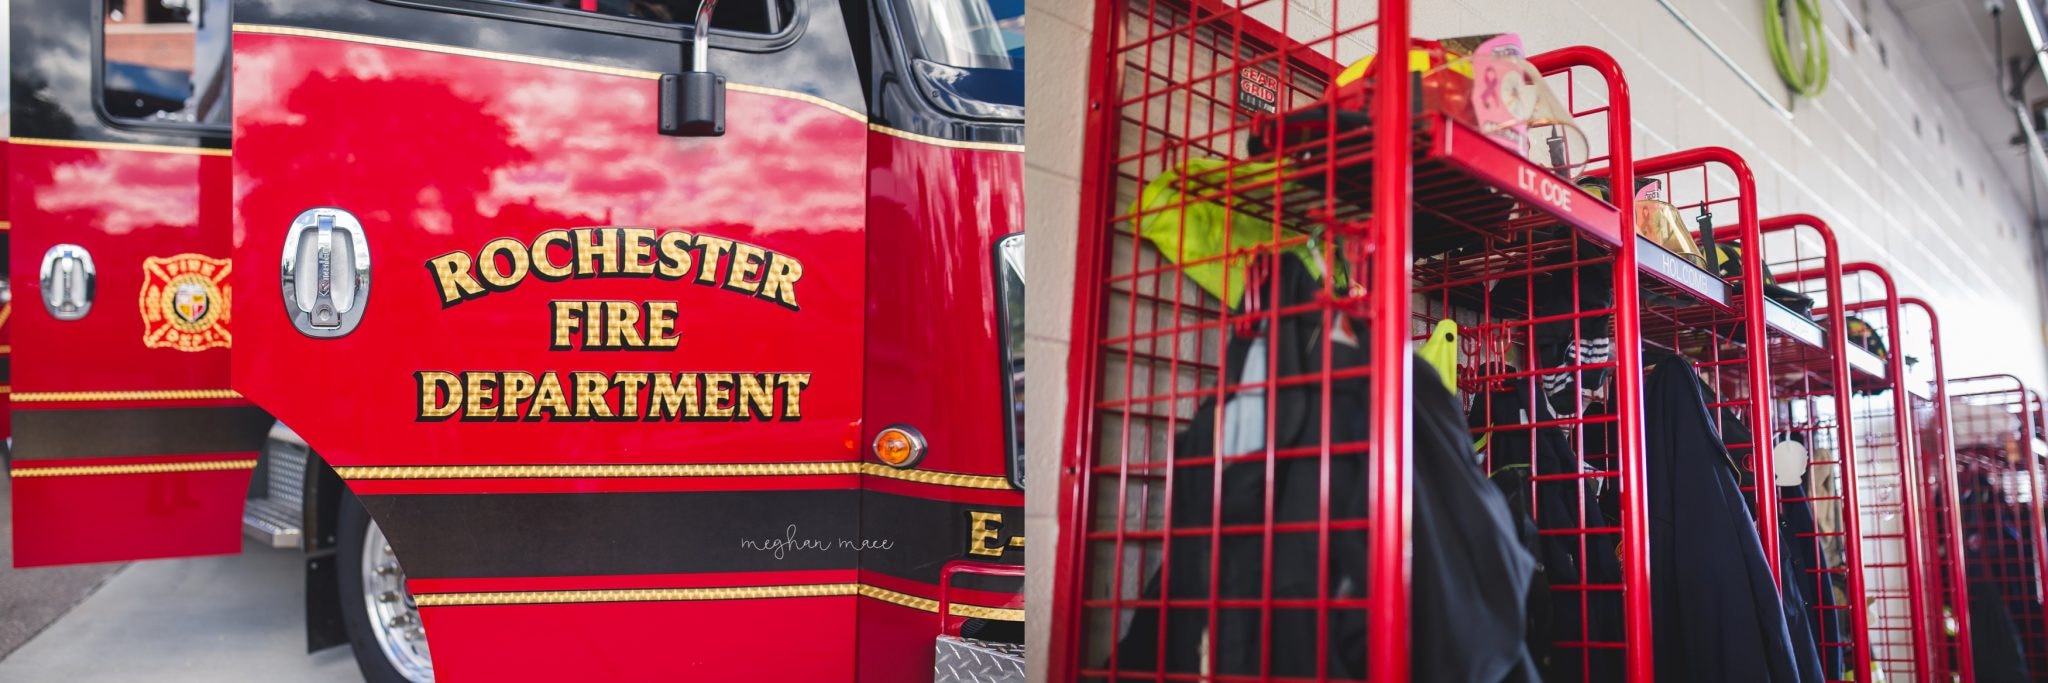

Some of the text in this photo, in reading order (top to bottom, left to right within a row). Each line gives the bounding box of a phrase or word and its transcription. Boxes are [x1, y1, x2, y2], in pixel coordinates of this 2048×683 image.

[1241, 79, 1275, 103] GRID
[1517, 165, 1572, 212] LT. COE
[426, 227, 803, 311] ROCHESTER
[548, 300, 681, 352] FIRE
[413, 370, 811, 422] DEPARTMENT
